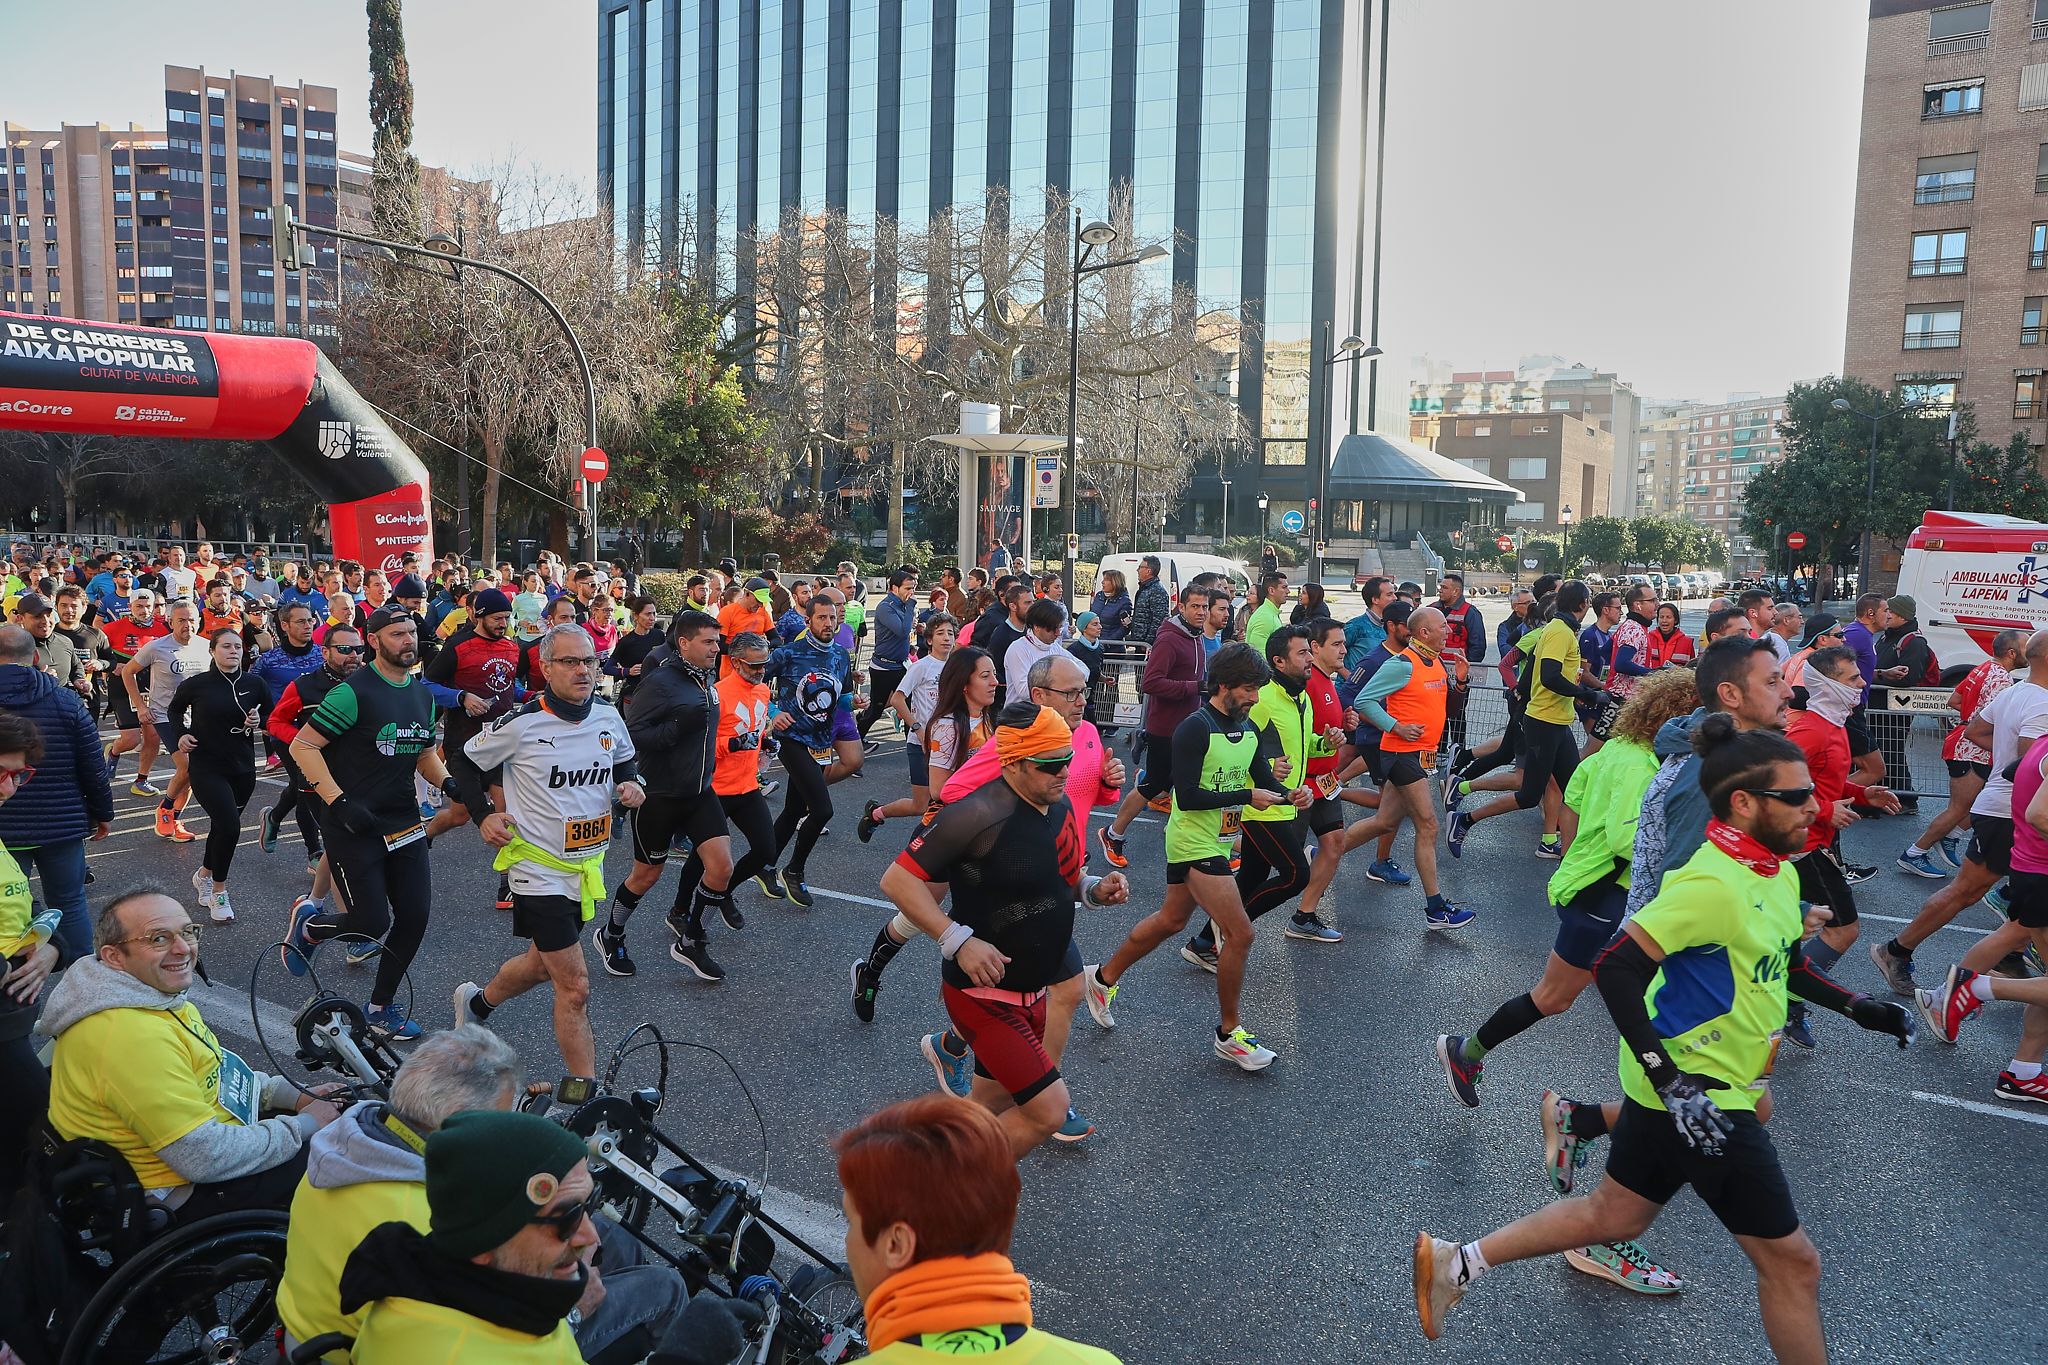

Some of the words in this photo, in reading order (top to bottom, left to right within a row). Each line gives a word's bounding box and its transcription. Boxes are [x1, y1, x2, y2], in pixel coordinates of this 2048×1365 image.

[7, 323, 48, 340] DE
[50, 328, 189, 353] CARRERES
[0, 340, 76, 362] AIXA
[78, 346, 196, 373] POPULAR
[80, 366, 121, 379] CIUTAT
[125, 371, 141, 381] DE
[143, 370, 199, 386] VALÈNCIA
[136, 414, 186, 422] popular
[139, 407, 171, 416] caixa
[979, 505, 1021, 513] SAUVAGE
[1951, 570, 2039, 586] AMBULANCIAS
[1961, 586, 2009, 601] LAPEÑA
[1939, 601, 2048, 615] www.ambulancias-lapenya.co
[1911, 701, 1939, 709] CIUDAD
[548, 761, 611, 789] bwin
[1226, 812, 1241, 829] 38
[571, 818, 606, 841] 3864
